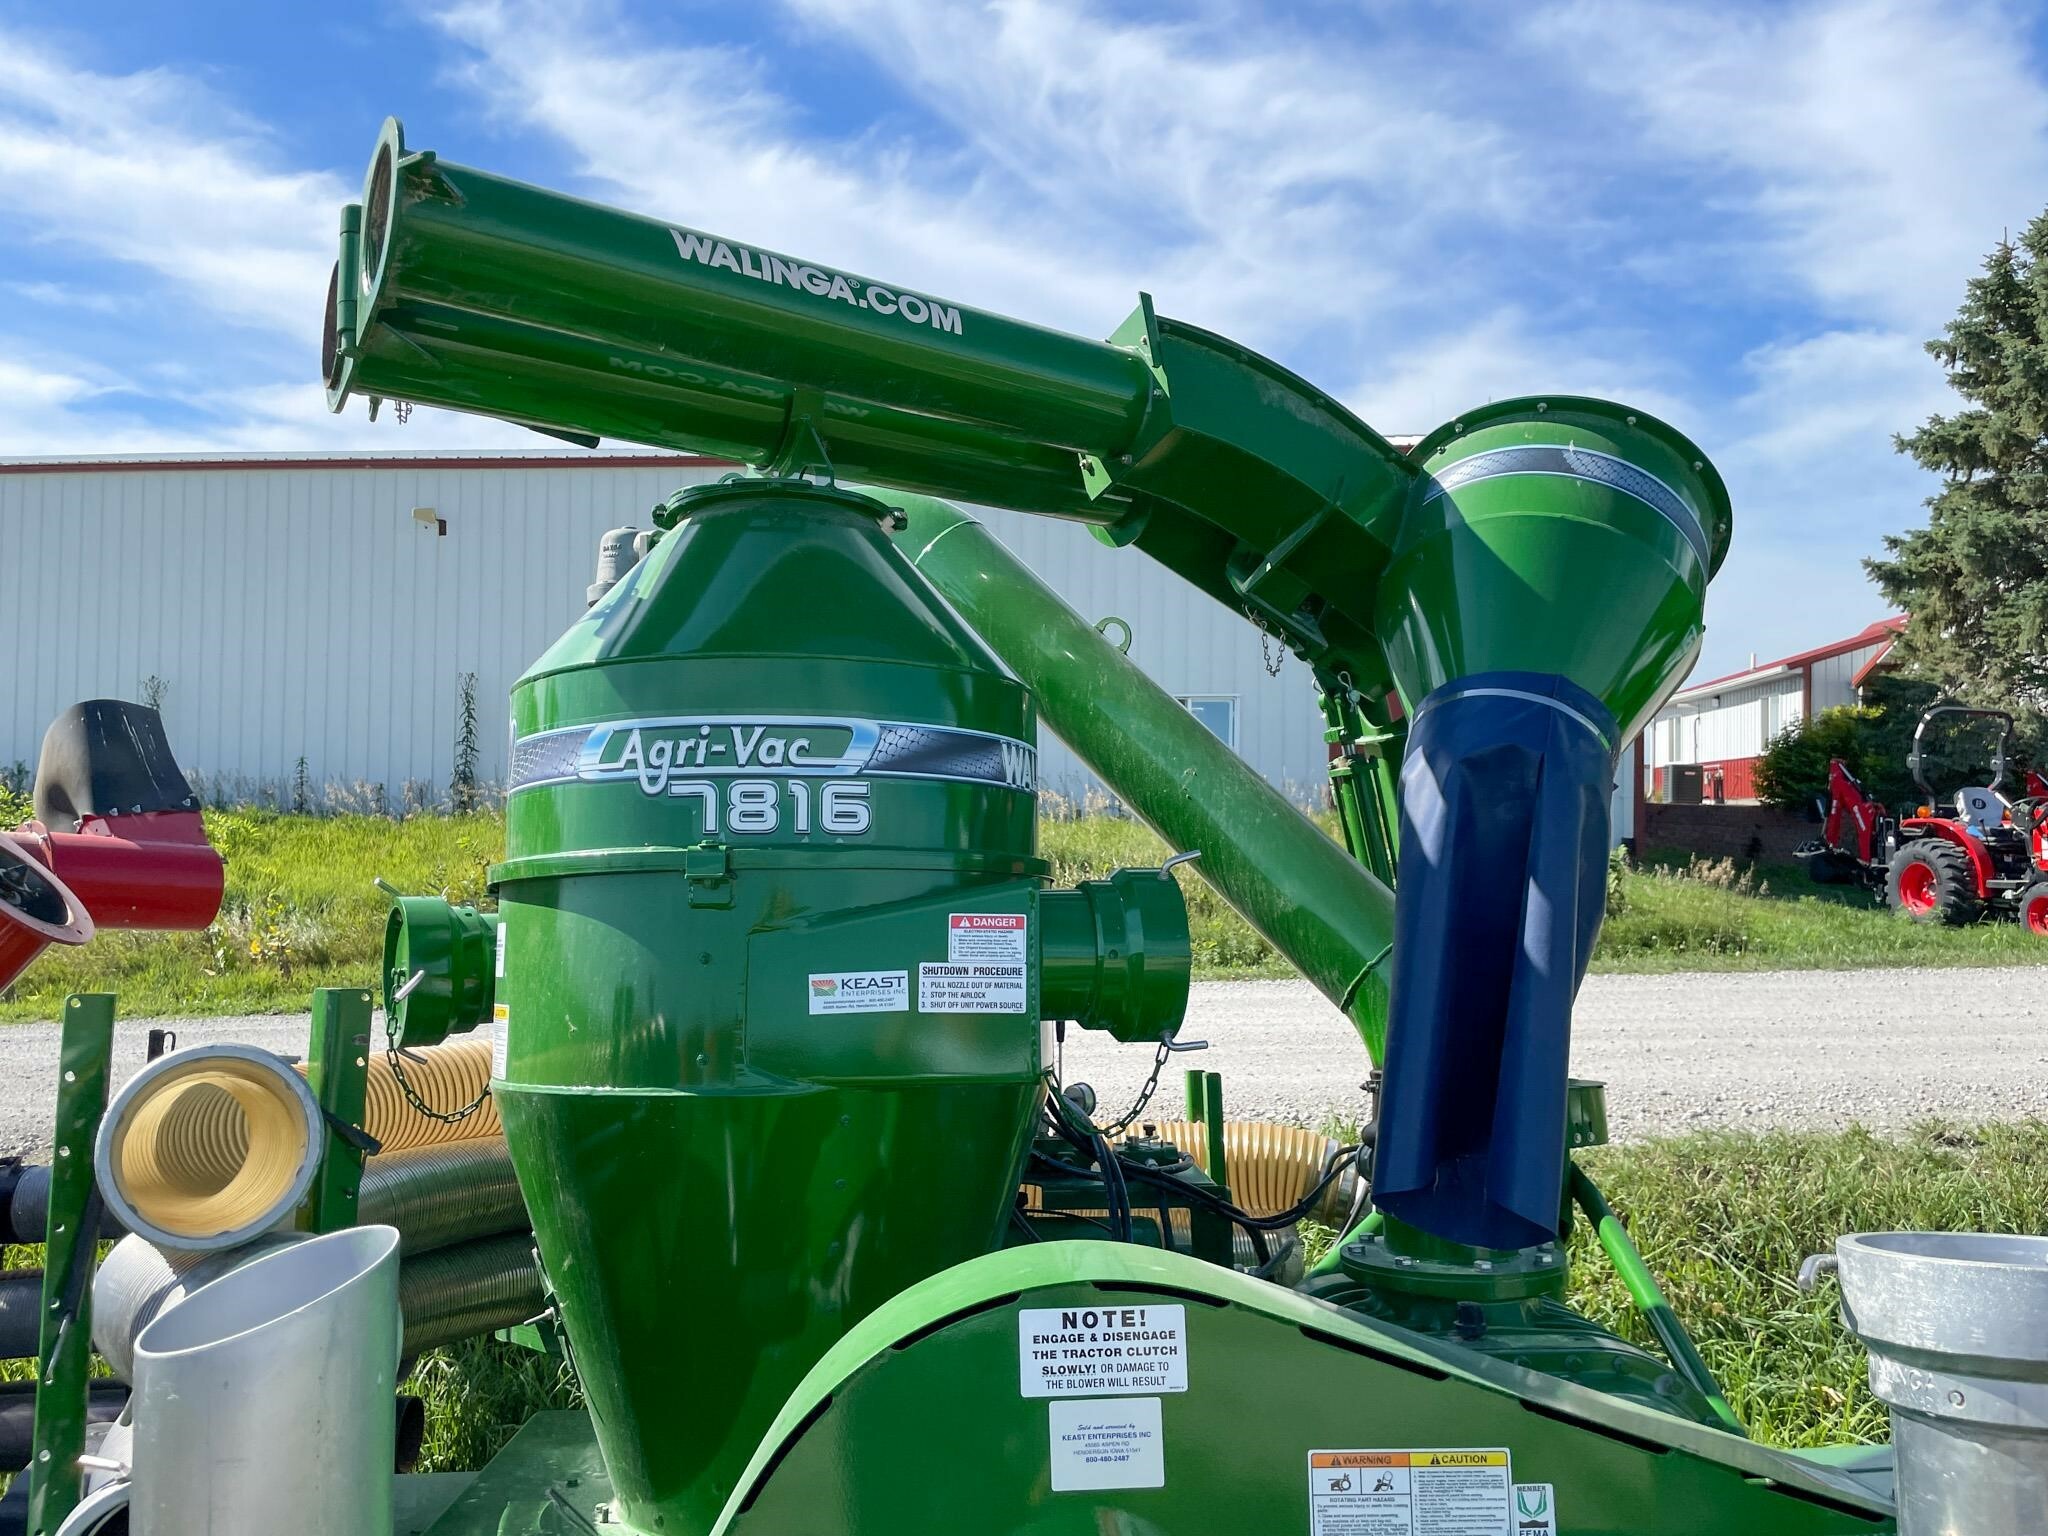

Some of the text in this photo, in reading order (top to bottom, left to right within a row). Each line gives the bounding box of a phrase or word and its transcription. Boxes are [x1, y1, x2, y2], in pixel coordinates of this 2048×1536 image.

[608, 725, 820, 795] Agri-Vac
[668, 779, 872, 834] 7816
[973, 918, 1016, 927] DANGER
[922, 966, 1023, 976] SHUTDOWN PROCEDURE
[841, 976, 905, 990] KEAST
[841, 989, 891, 997] ENTERPRISES
[1062, 1309, 1146, 1329] NOTE!
[1033, 1330, 1176, 1344] ENGAGE & DISENGAGE
[1033, 1346, 1178, 1359] THE TRACTOR CLUTCH
[1042, 1361, 1169, 1375] SLOWLY! OR DAMAGE TO
[1046, 1376, 1166, 1389] THE BLOWER WILL RESULT
[1088, 1432, 1137, 1440] ENTERPRISES
[1343, 1456, 1392, 1464] WARNING
[1442, 1455, 1488, 1464] CAUTION
